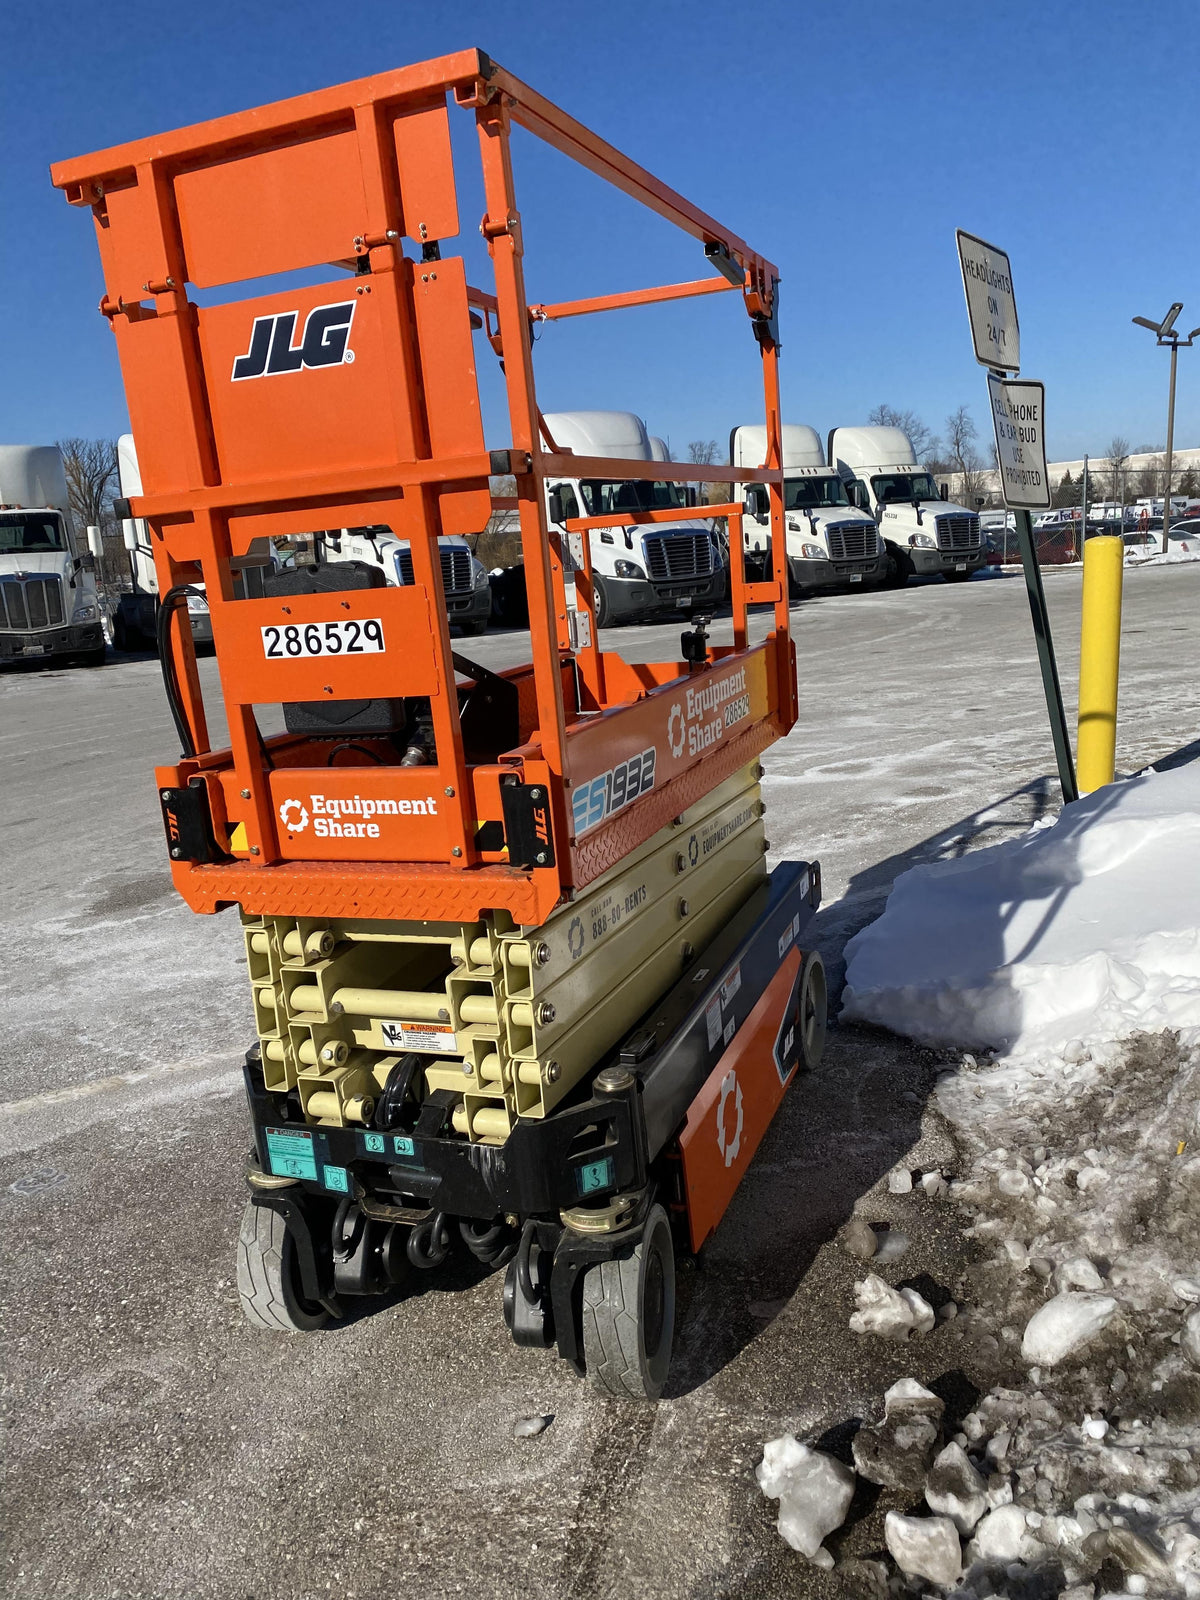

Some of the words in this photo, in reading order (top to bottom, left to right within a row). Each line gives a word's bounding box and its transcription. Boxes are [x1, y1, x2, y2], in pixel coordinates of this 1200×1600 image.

[964, 257, 1011, 294] HEADLIGHTS
[987, 296, 999, 315] ON
[986, 323, 1007, 346] 24/7
[994, 398, 1008, 418] CELL
[1008, 404, 1038, 421] PHONE
[1000, 421, 1005, 437] &
[1007, 423, 1018, 441] EAR
[1019, 427, 1036, 443] BUD
[1012, 447, 1024, 464] USE
[1005, 466, 1041, 487] PROHIBITED
[1060, 509, 1082, 521] FedEx
[264, 620, 384, 657] 286529
[686, 666, 747, 721] Equipment
[724, 694, 750, 728] 286529
[688, 717, 723, 757] Share
[572, 745, 657, 835] ES1932
[310, 794, 438, 819] Equipment
[166, 807, 181, 842] JLG
[313, 818, 380, 838] Share
[533, 807, 549, 846] JLG
[592, 884, 647, 940] 888-80-RENTS
[416, 1024, 446, 1033] WARNING
